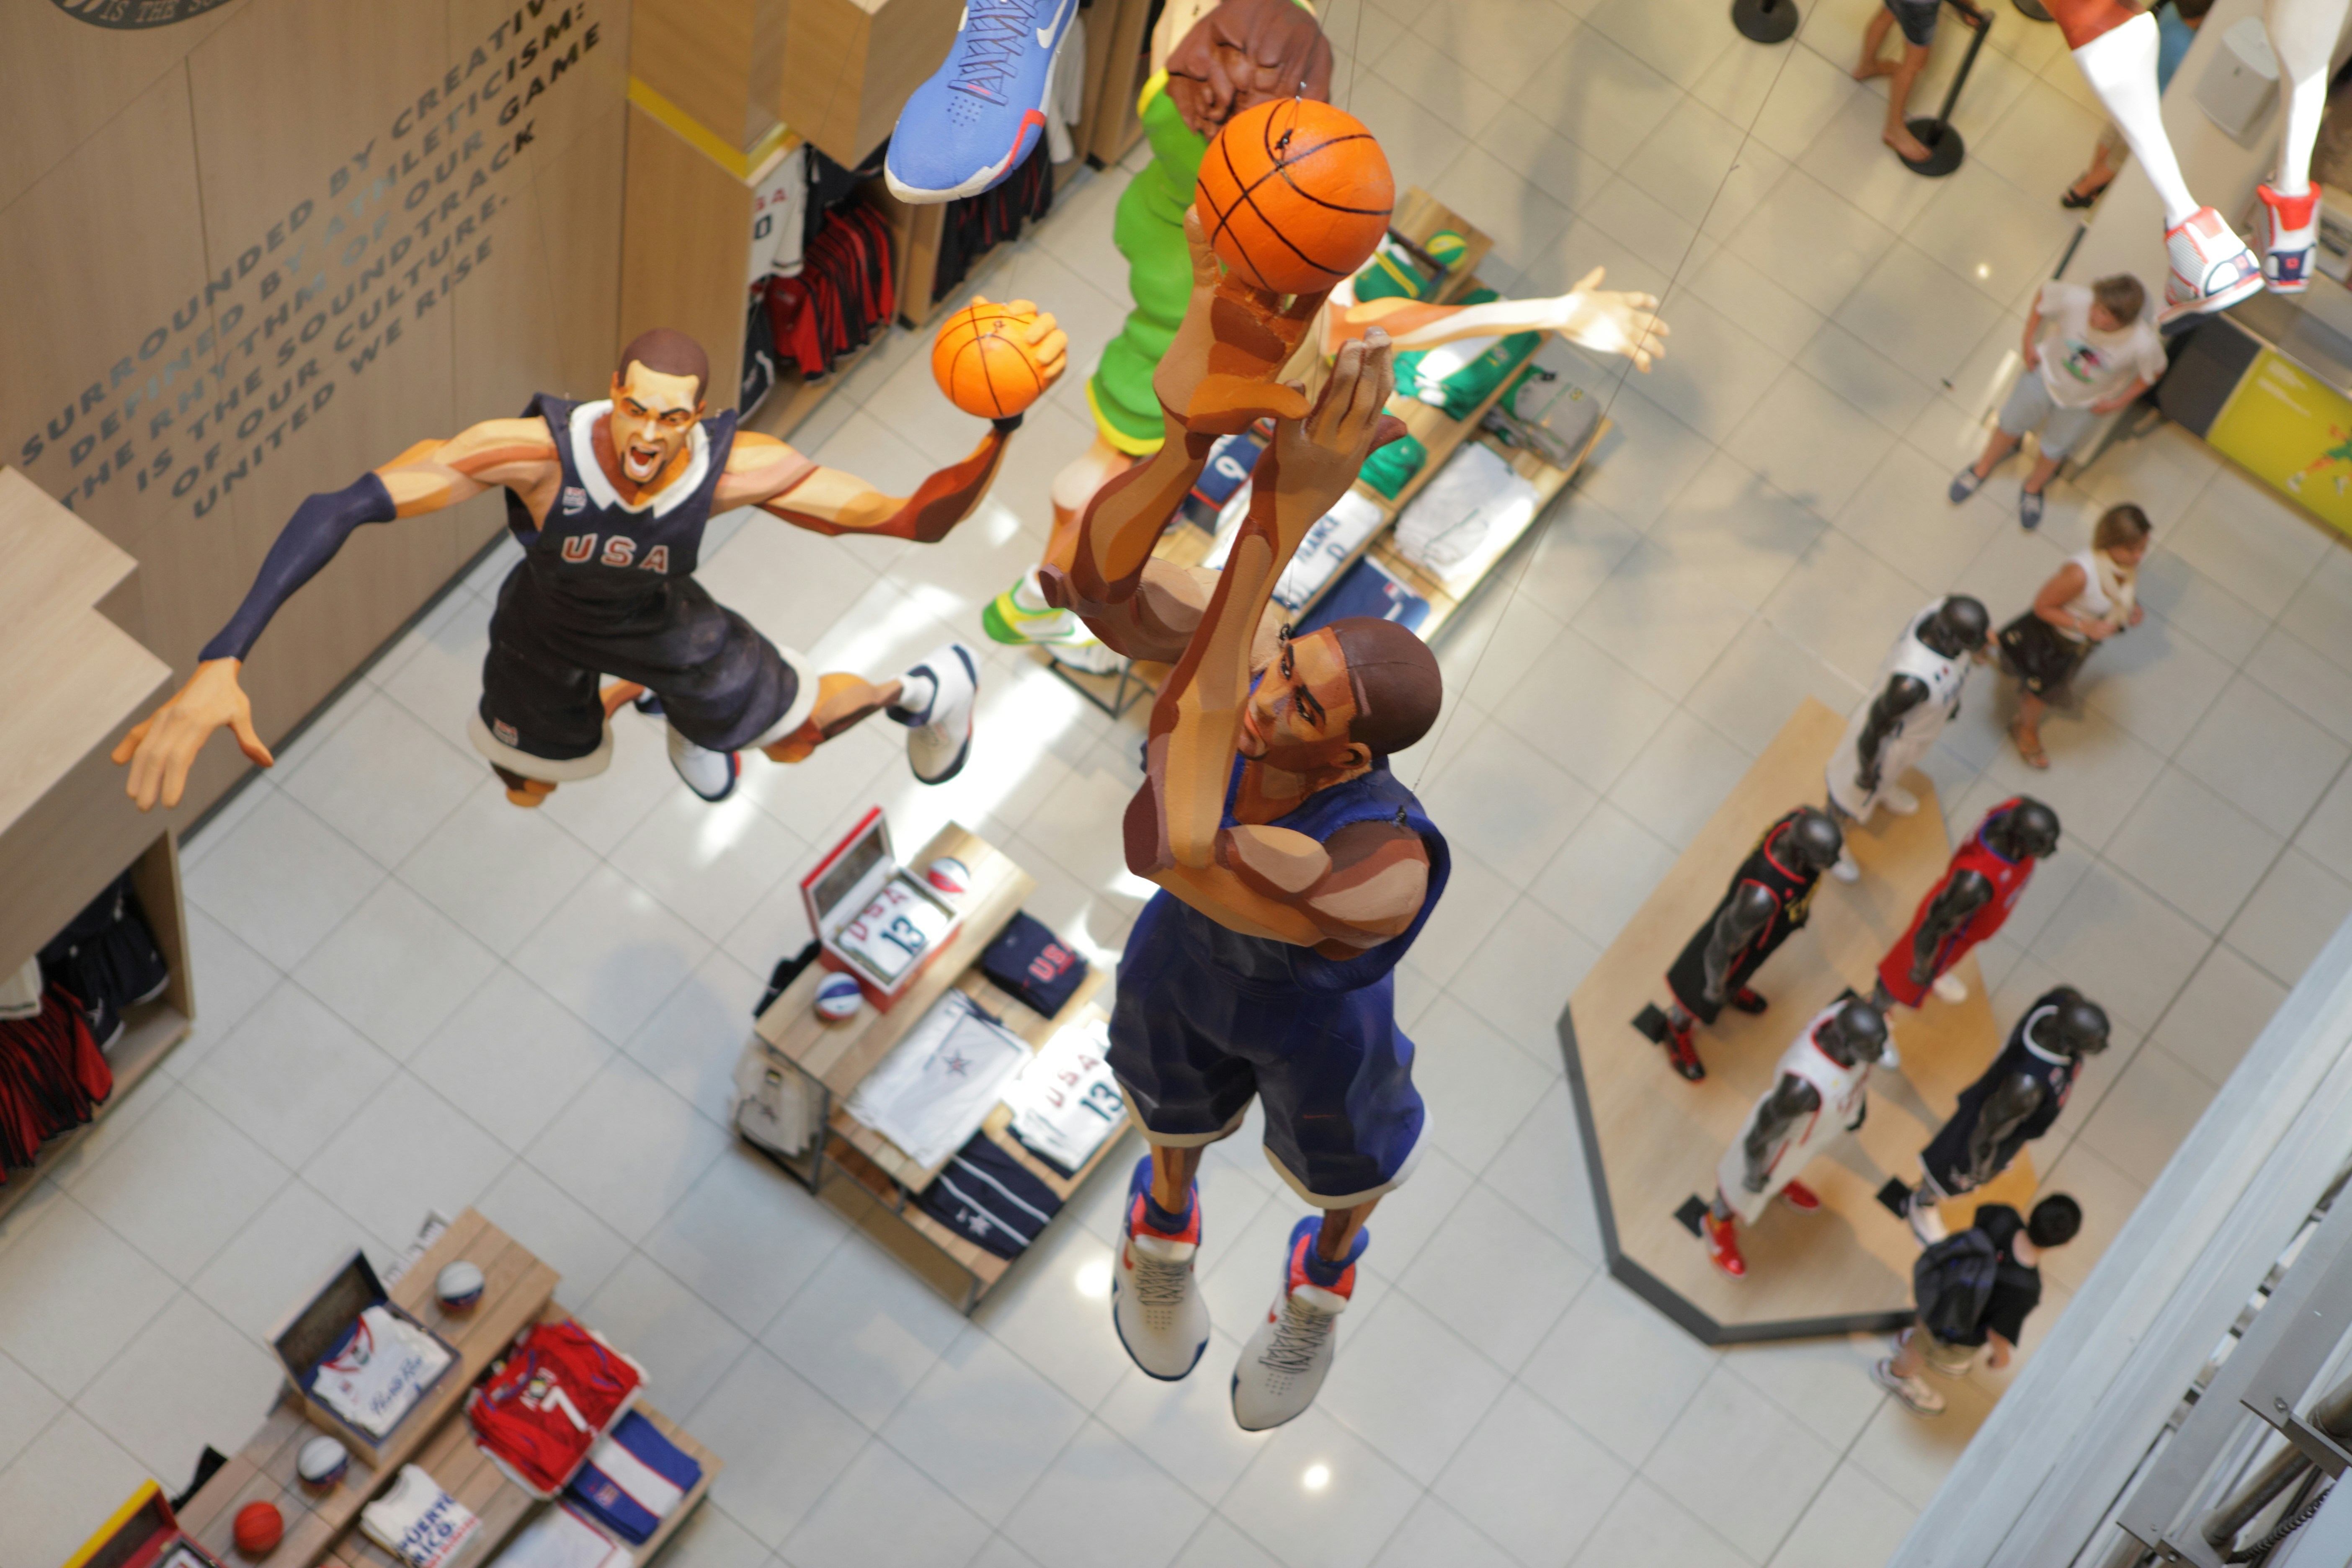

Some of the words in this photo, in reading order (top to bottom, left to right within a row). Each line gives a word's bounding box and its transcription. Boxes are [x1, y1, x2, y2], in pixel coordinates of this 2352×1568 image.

[99, 3, 126, 21] IS
[136, 3, 175, 22] THE
[754, 188, 788, 211] SA
[22, 199, 313, 466] SURROUNDED
[330, 139, 375, 198] BY
[392, 0, 556, 139] CREATIV
[70, 304, 244, 468] DEFINED
[260, 243, 307, 302] BY
[322, 2, 584, 248] ATHLETICISM:
[60, 439, 134, 512] THE
[150, 269, 326, 440] RHYTHM
[341, 210, 391, 268] OF
[405, 129, 485, 210] OUR
[498, 21, 600, 126] GAME
[137, 447, 173, 493] IS
[187, 366, 263, 441] THE
[277, 118, 535, 369] SOUNDTRACK
[172, 441, 221, 498] OF
[237, 358, 319, 439] OUR
[334, 194, 508, 353] CULTURE.
[194, 382, 335, 518] UNITED
[349, 316, 402, 375] WE
[415, 235, 493, 320] RISE
[561, 533, 669, 575] USA
[847, 887, 909, 941] USA
[880, 916, 926, 955] 13
[1045, 1054, 1100, 1108] USA
[1079, 1081, 1124, 1122] 13
[540, 1386, 588, 1434] 7
